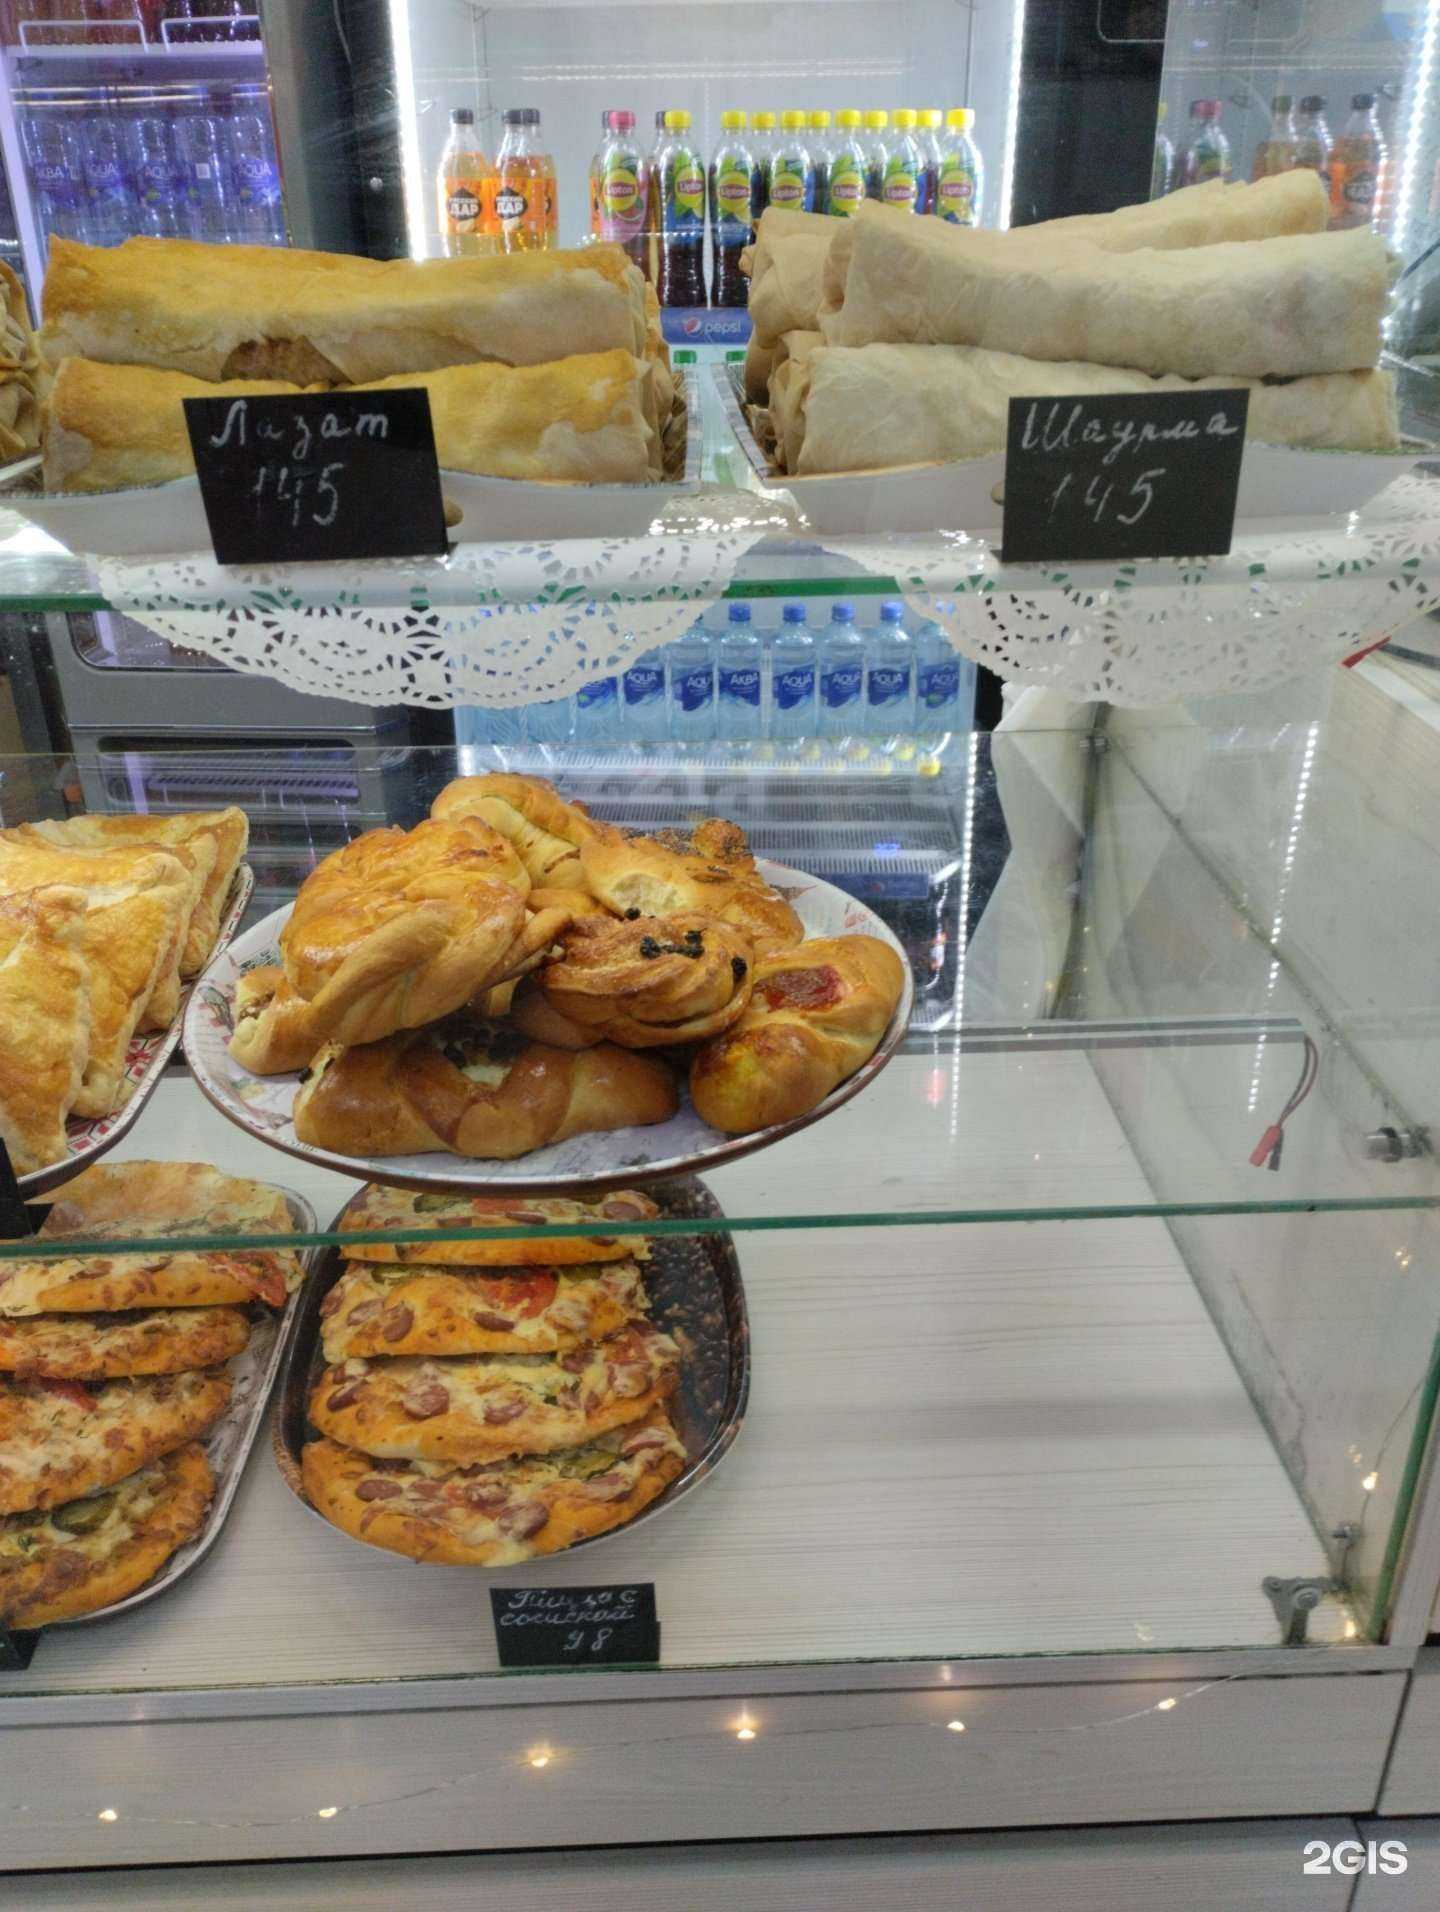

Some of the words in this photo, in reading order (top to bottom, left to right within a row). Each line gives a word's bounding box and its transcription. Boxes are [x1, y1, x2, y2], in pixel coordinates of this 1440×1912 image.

[704, 319, 741, 335] pepsi
[1021, 401, 1239, 466] Шаурма
[253, 462, 345, 527] 145
[1046, 467, 1167, 525] 145
[626, 671, 657, 684] AQUA
[782, 674, 812, 688] AQUA
[831, 672, 860, 685] AQUA
[872, 671, 903, 685] AQUA
